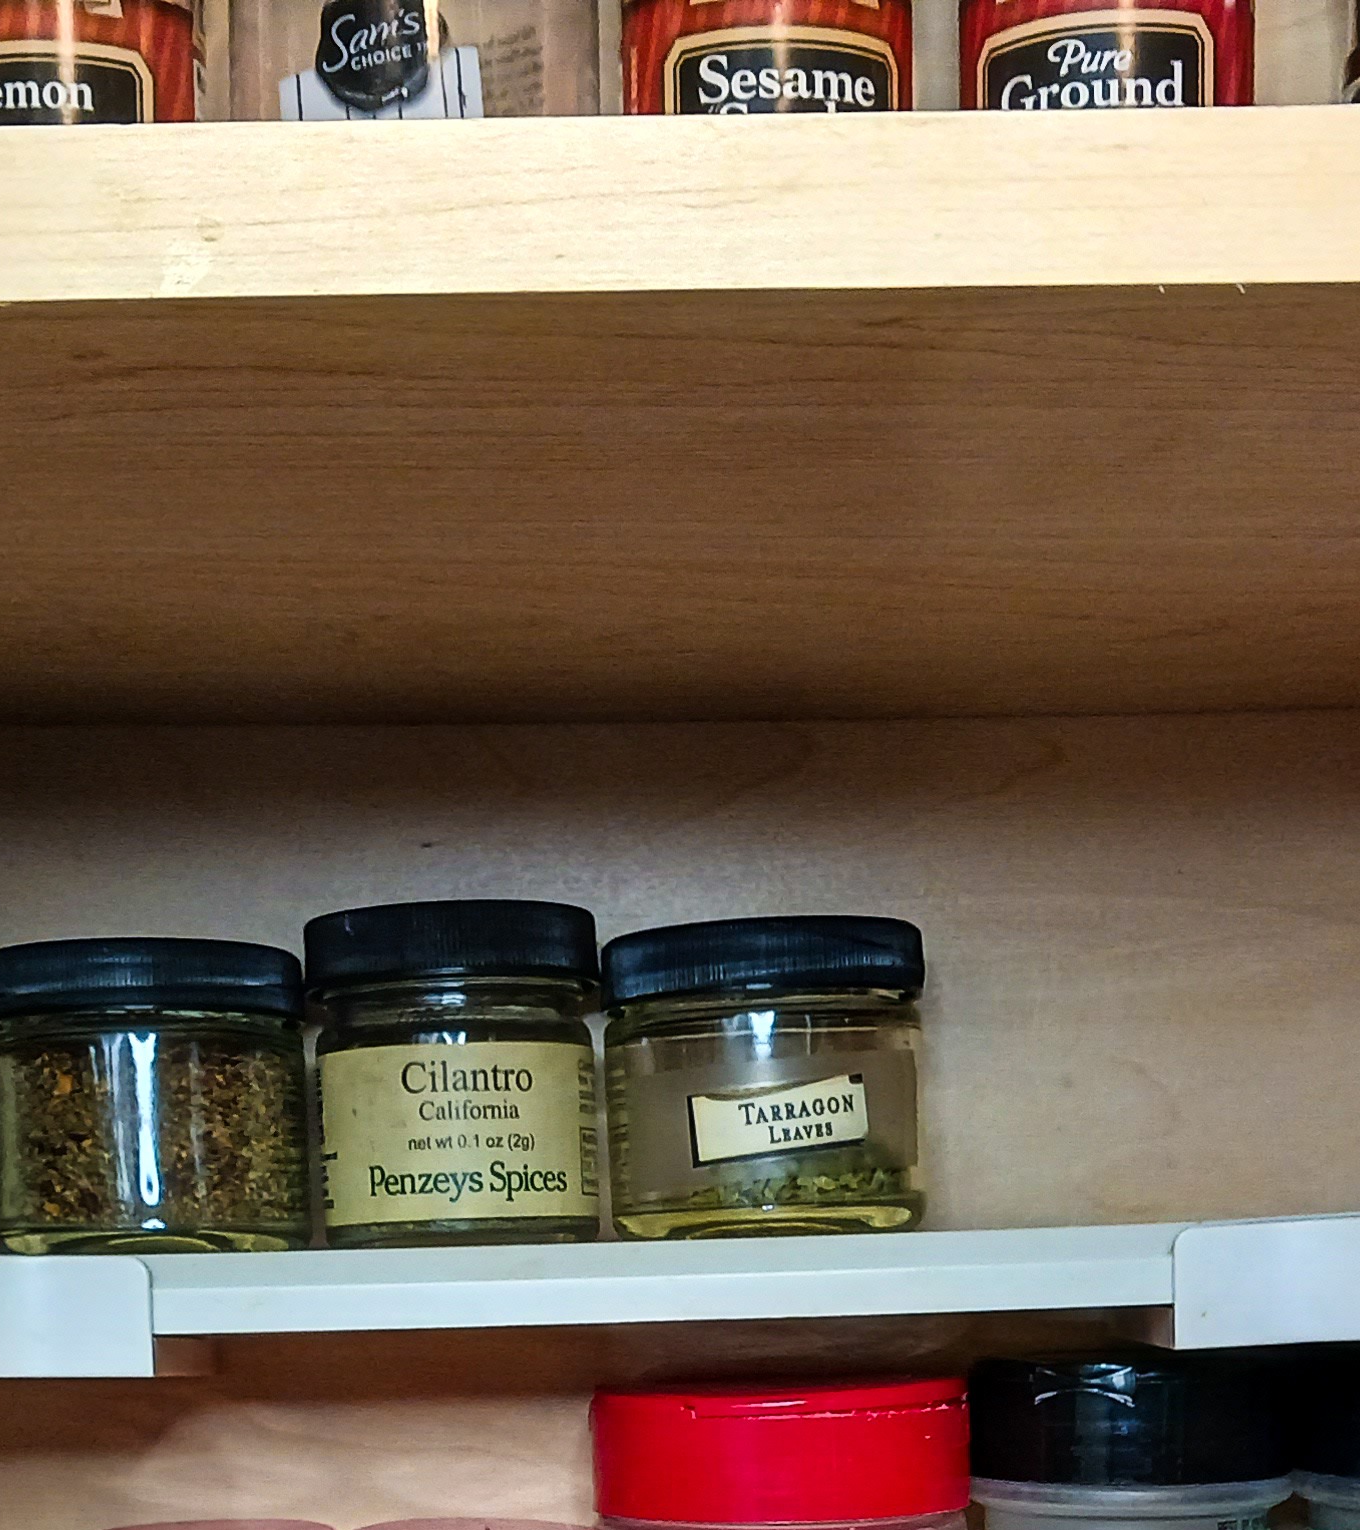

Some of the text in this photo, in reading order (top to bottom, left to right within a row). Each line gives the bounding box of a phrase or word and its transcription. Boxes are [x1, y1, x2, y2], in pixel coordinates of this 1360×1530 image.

[322, 8, 420, 73] Sam's
[1048, 39, 1132, 79] Pure
[697, 54, 876, 109] Sesame
[1001, 60, 1184, 110] Ground
[401, 1059, 534, 1096] Cilantro
[418, 1098, 521, 1123] California
[738, 1093, 856, 1127] TARRAGON
[408, 1130, 535, 1154] net wt 0.1 oz (2g)
[768, 1120, 834, 1146] LEAVES
[369, 1162, 568, 1209] Penzeys Spices
